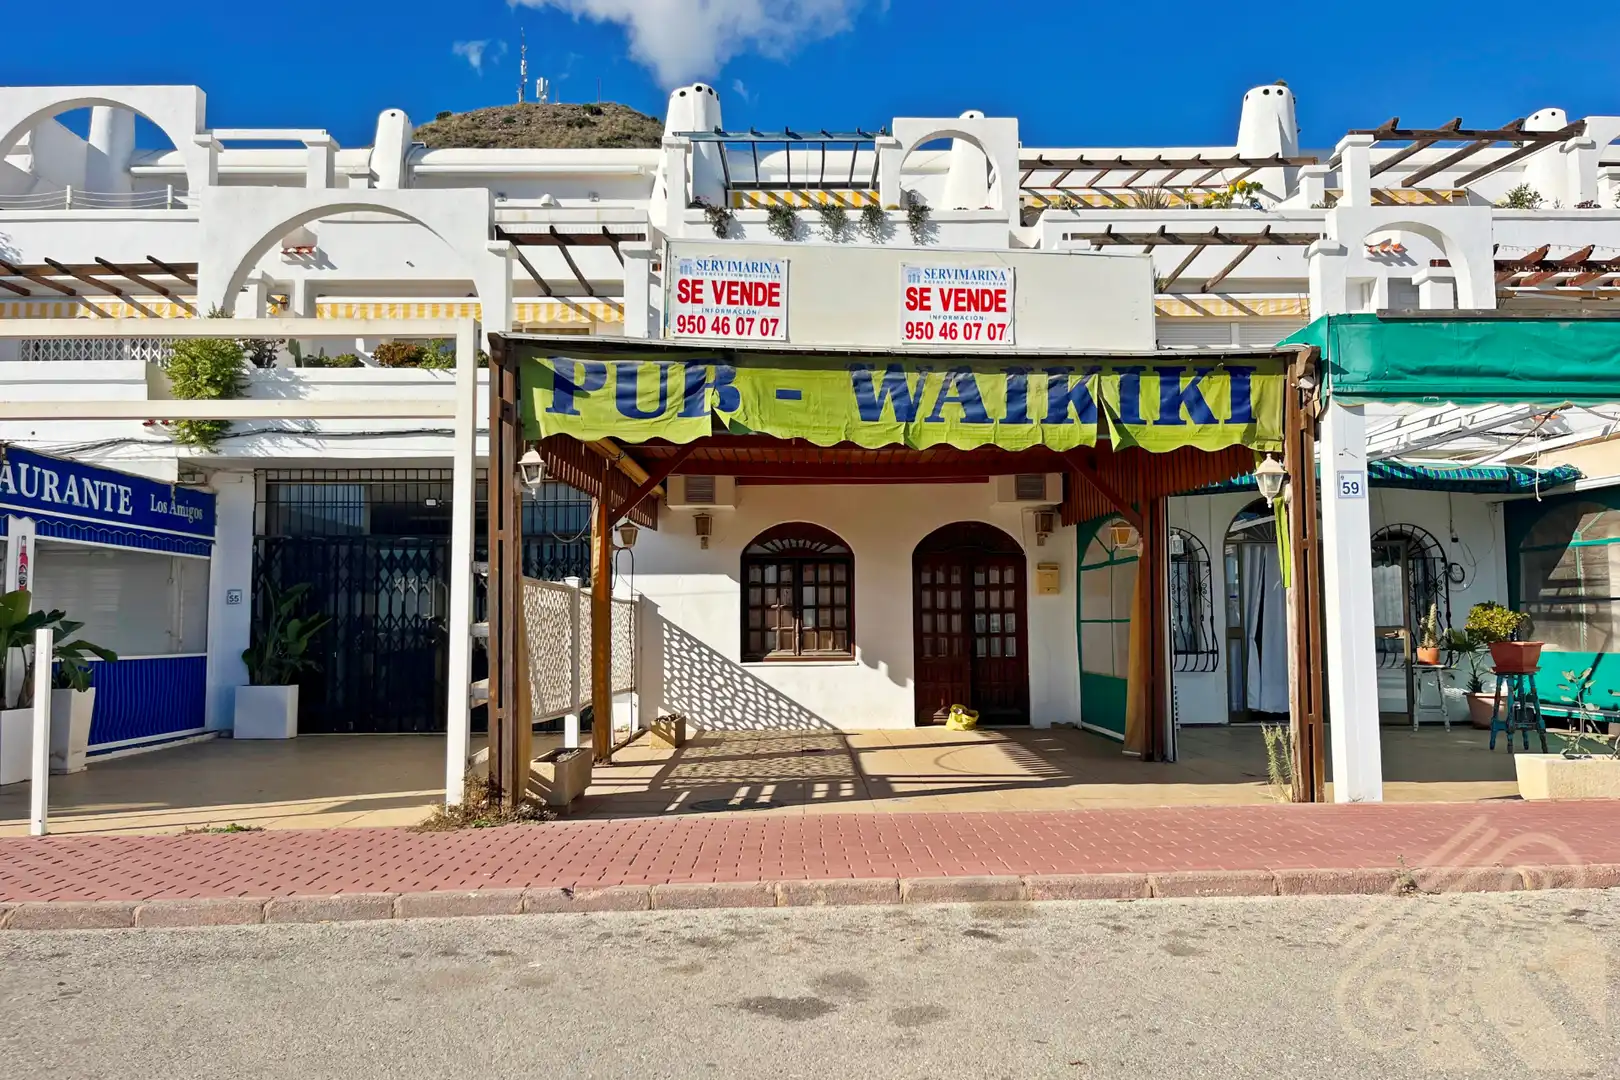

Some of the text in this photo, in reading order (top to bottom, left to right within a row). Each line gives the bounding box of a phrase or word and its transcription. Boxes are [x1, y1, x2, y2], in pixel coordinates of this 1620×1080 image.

[696, 259, 780, 274] SERVIMARINA
[924, 267, 1006, 281] SERVIMARINA
[677, 279, 781, 307] SE VENDE
[905, 286, 1007, 313] SE VENDE
[677, 314, 779, 337] 950 46 07 07
[905, 321, 1006, 341] 950 46 07 07
[545, 355, 741, 419] PUB
[844, 362, 1258, 426] WAIKIKI
[1342, 481, 1360, 495] 59
[150, 493, 168, 514] Los
[169, 499, 204, 524] Amigos
